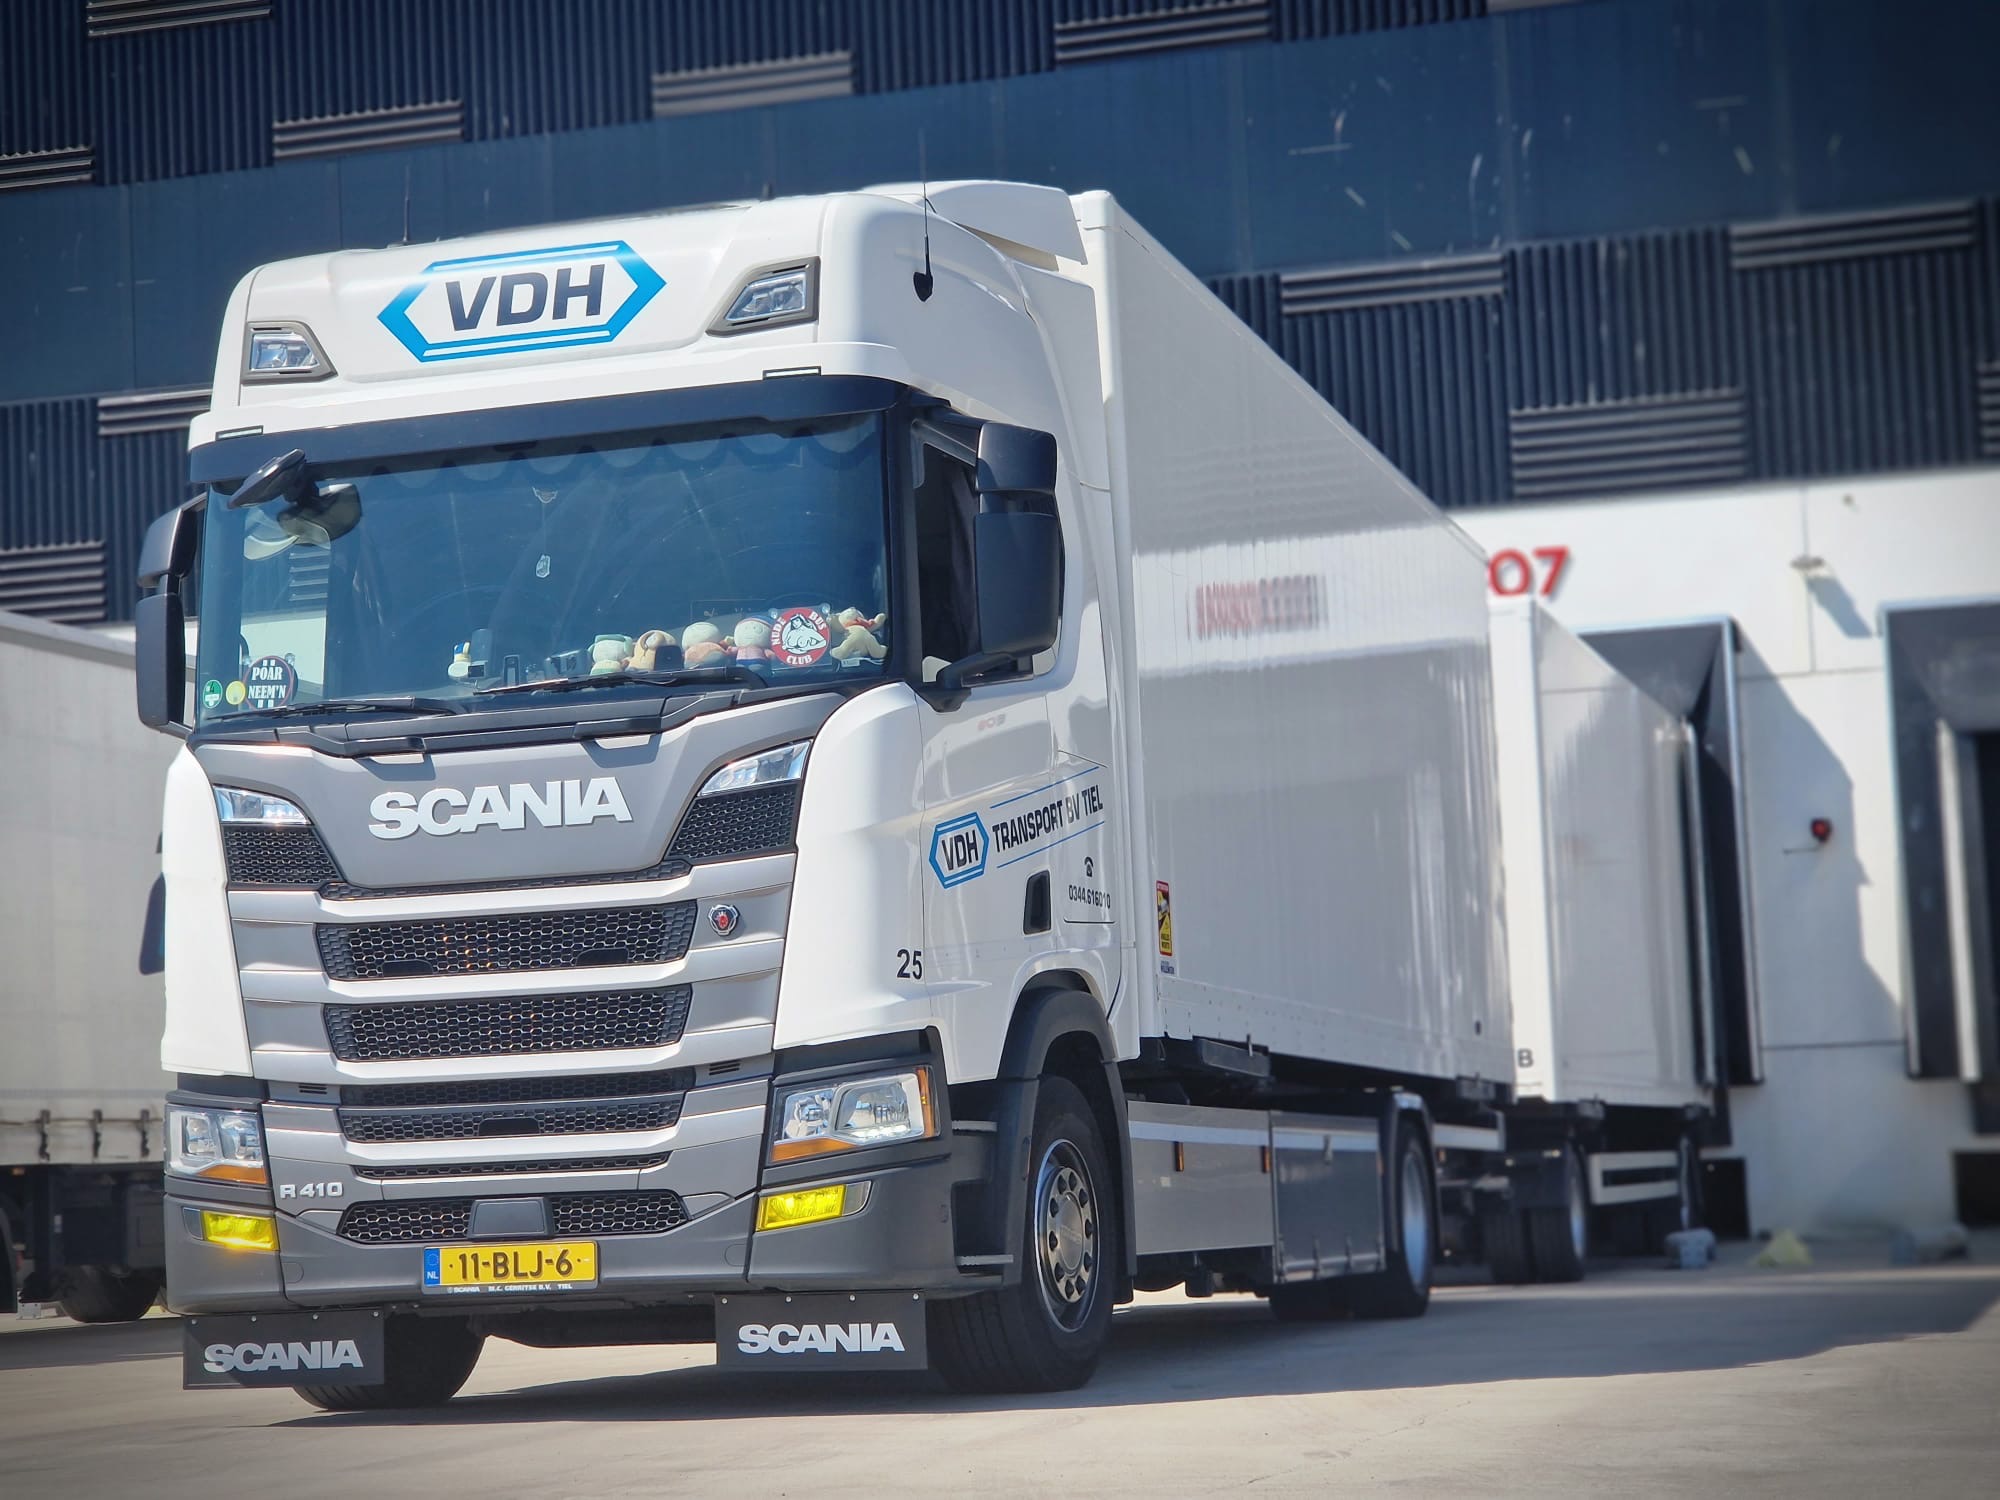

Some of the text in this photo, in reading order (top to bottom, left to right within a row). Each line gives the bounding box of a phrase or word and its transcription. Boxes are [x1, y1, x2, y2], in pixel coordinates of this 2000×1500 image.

[446, 263, 605, 331] VDH
[771, 611, 827, 646] NUDE BUS
[786, 655, 812, 665] CLUB
[369, 777, 633, 839] SCANIA
[992, 785, 1104, 853] TRANSPORT BV TIEL
[942, 830, 979, 871] VDH
[897, 949, 922, 980] 25
[1517, 1048, 1534, 1068] B
[279, 1182, 343, 1199] R 410
[426, 1271, 439, 1280] NL
[459, 1249, 573, 1281] 11-BLJ-6
[738, 1322, 905, 1355] SCANIA
[204, 1339, 364, 1373] SCANIA
